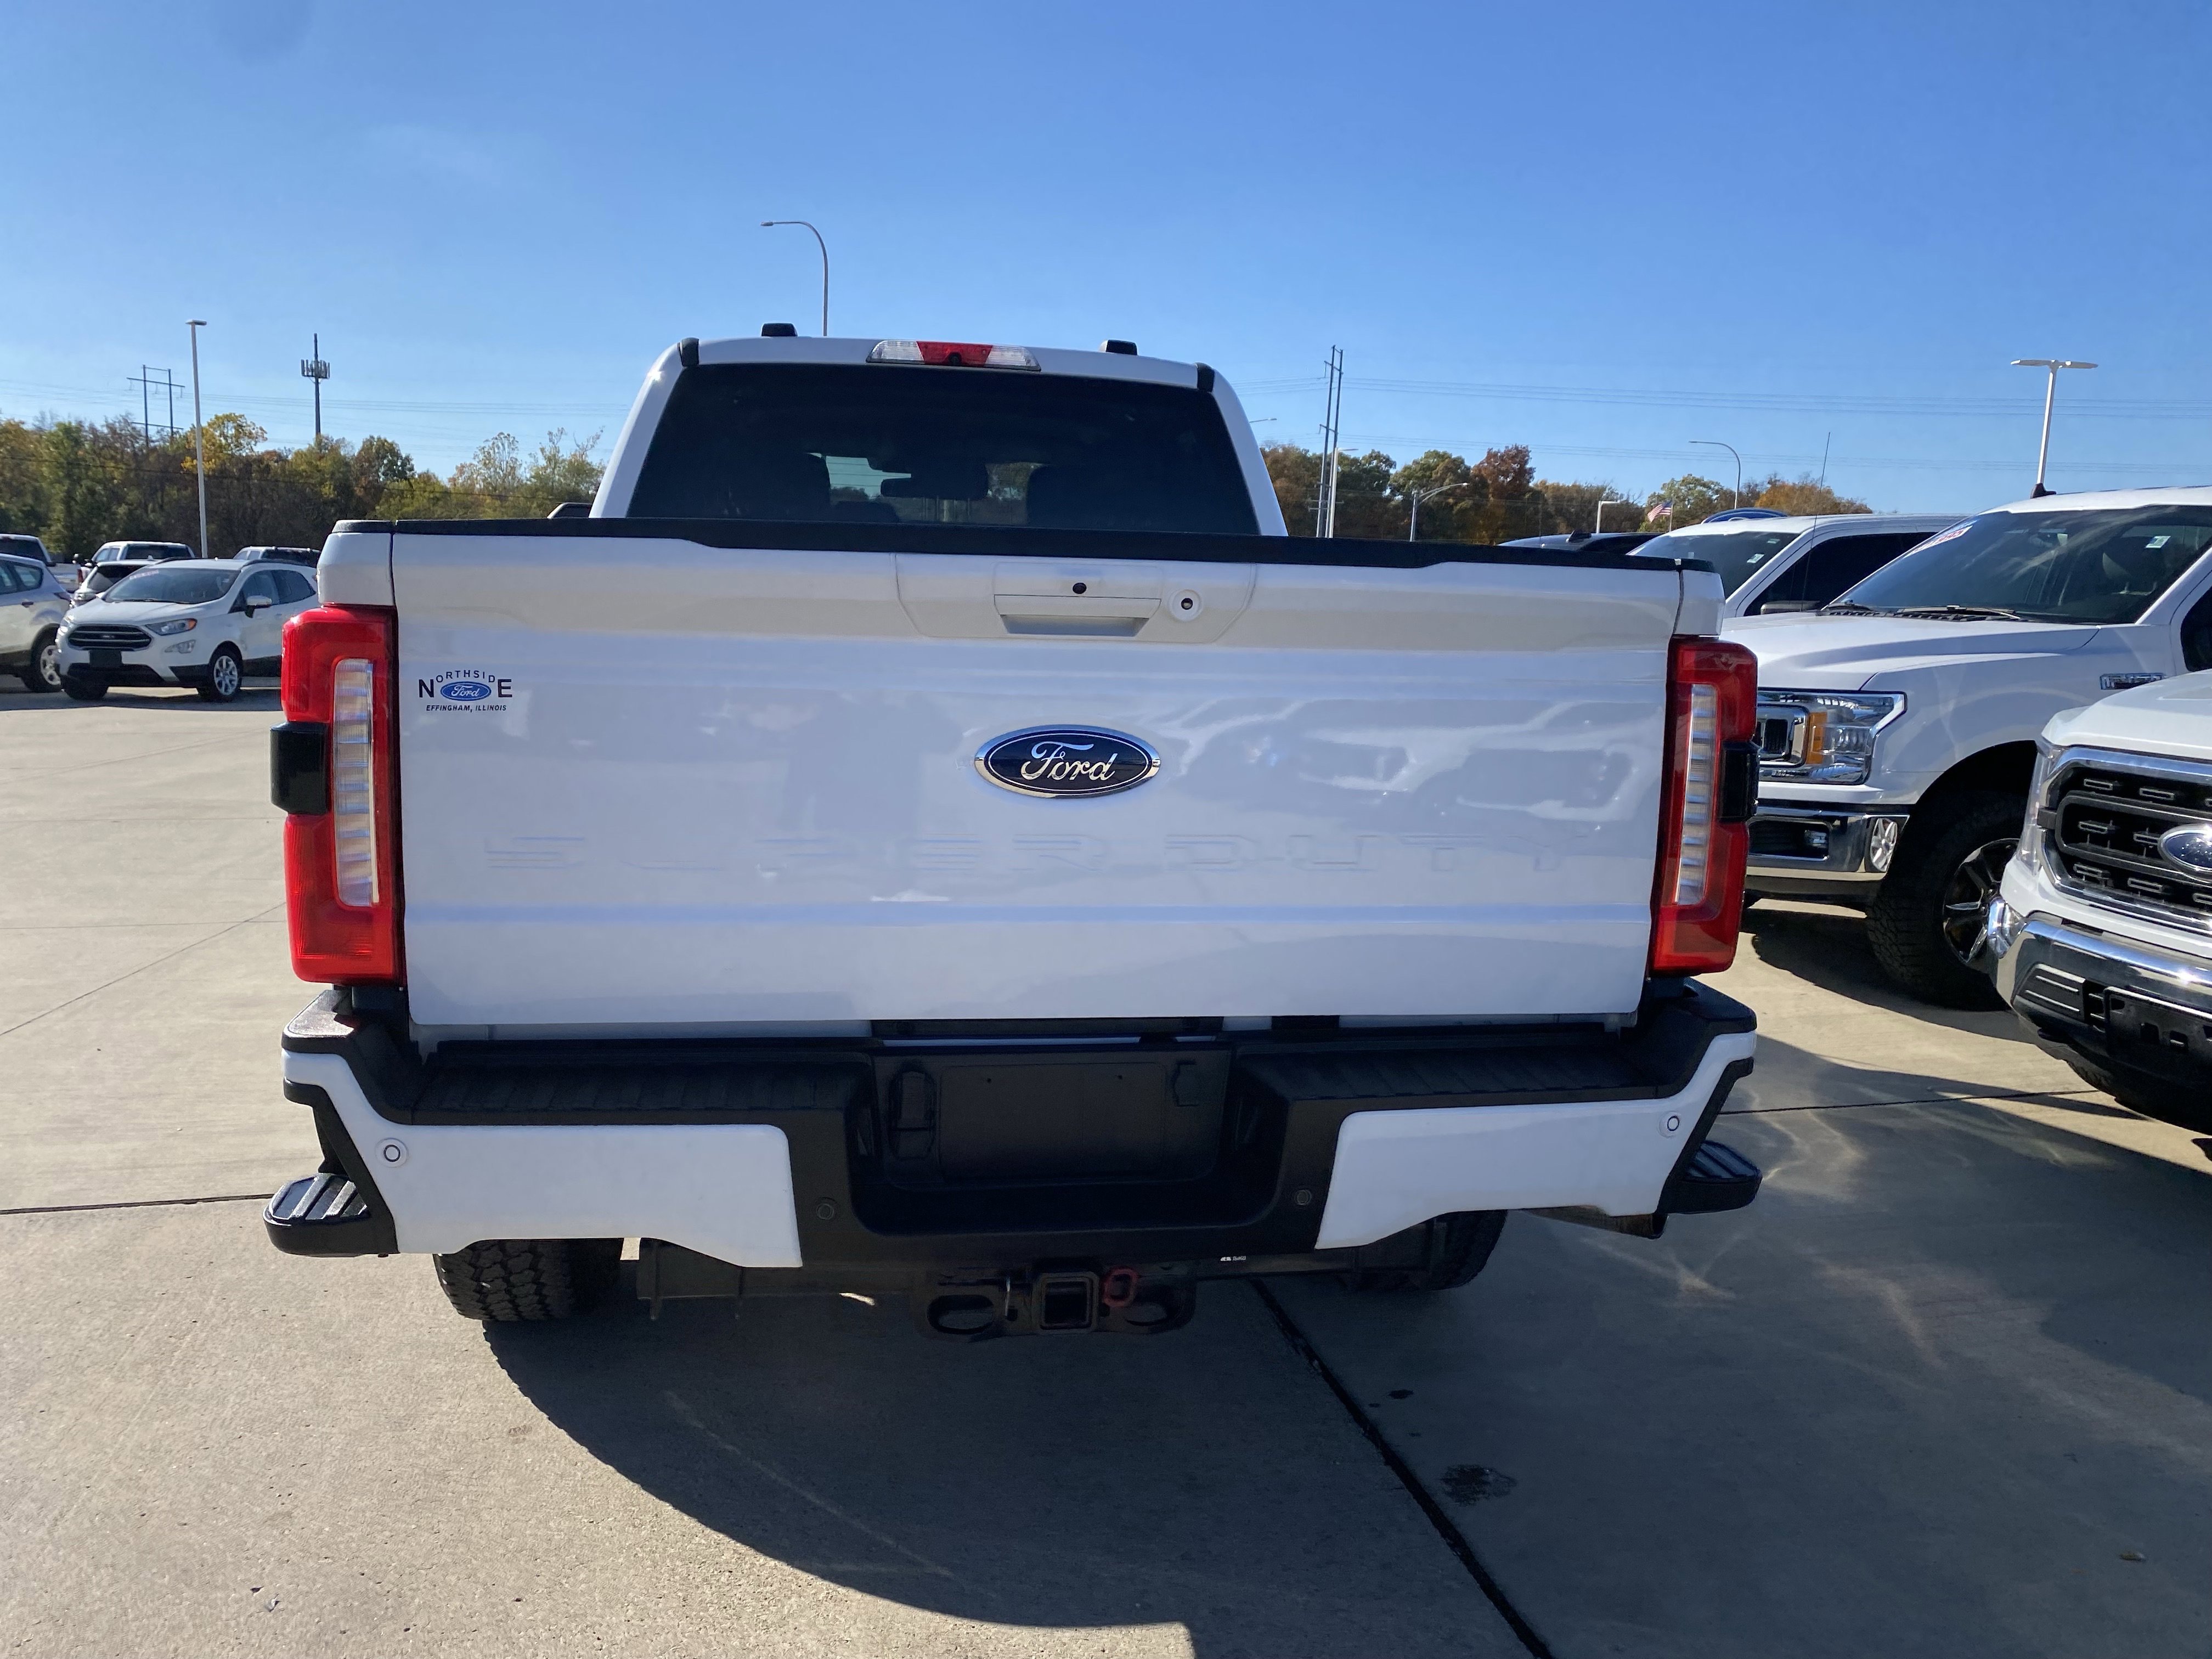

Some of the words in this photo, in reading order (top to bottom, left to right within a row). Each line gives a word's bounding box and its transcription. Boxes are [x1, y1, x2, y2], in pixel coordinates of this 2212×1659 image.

[418, 670, 513, 698] NORTHSIDE
[450, 684, 481, 697] Ford
[426, 704, 473, 713] EFFINGHAM,
[1020, 741, 1119, 781] Ford
[1164, 834, 1589, 873] DUTY
